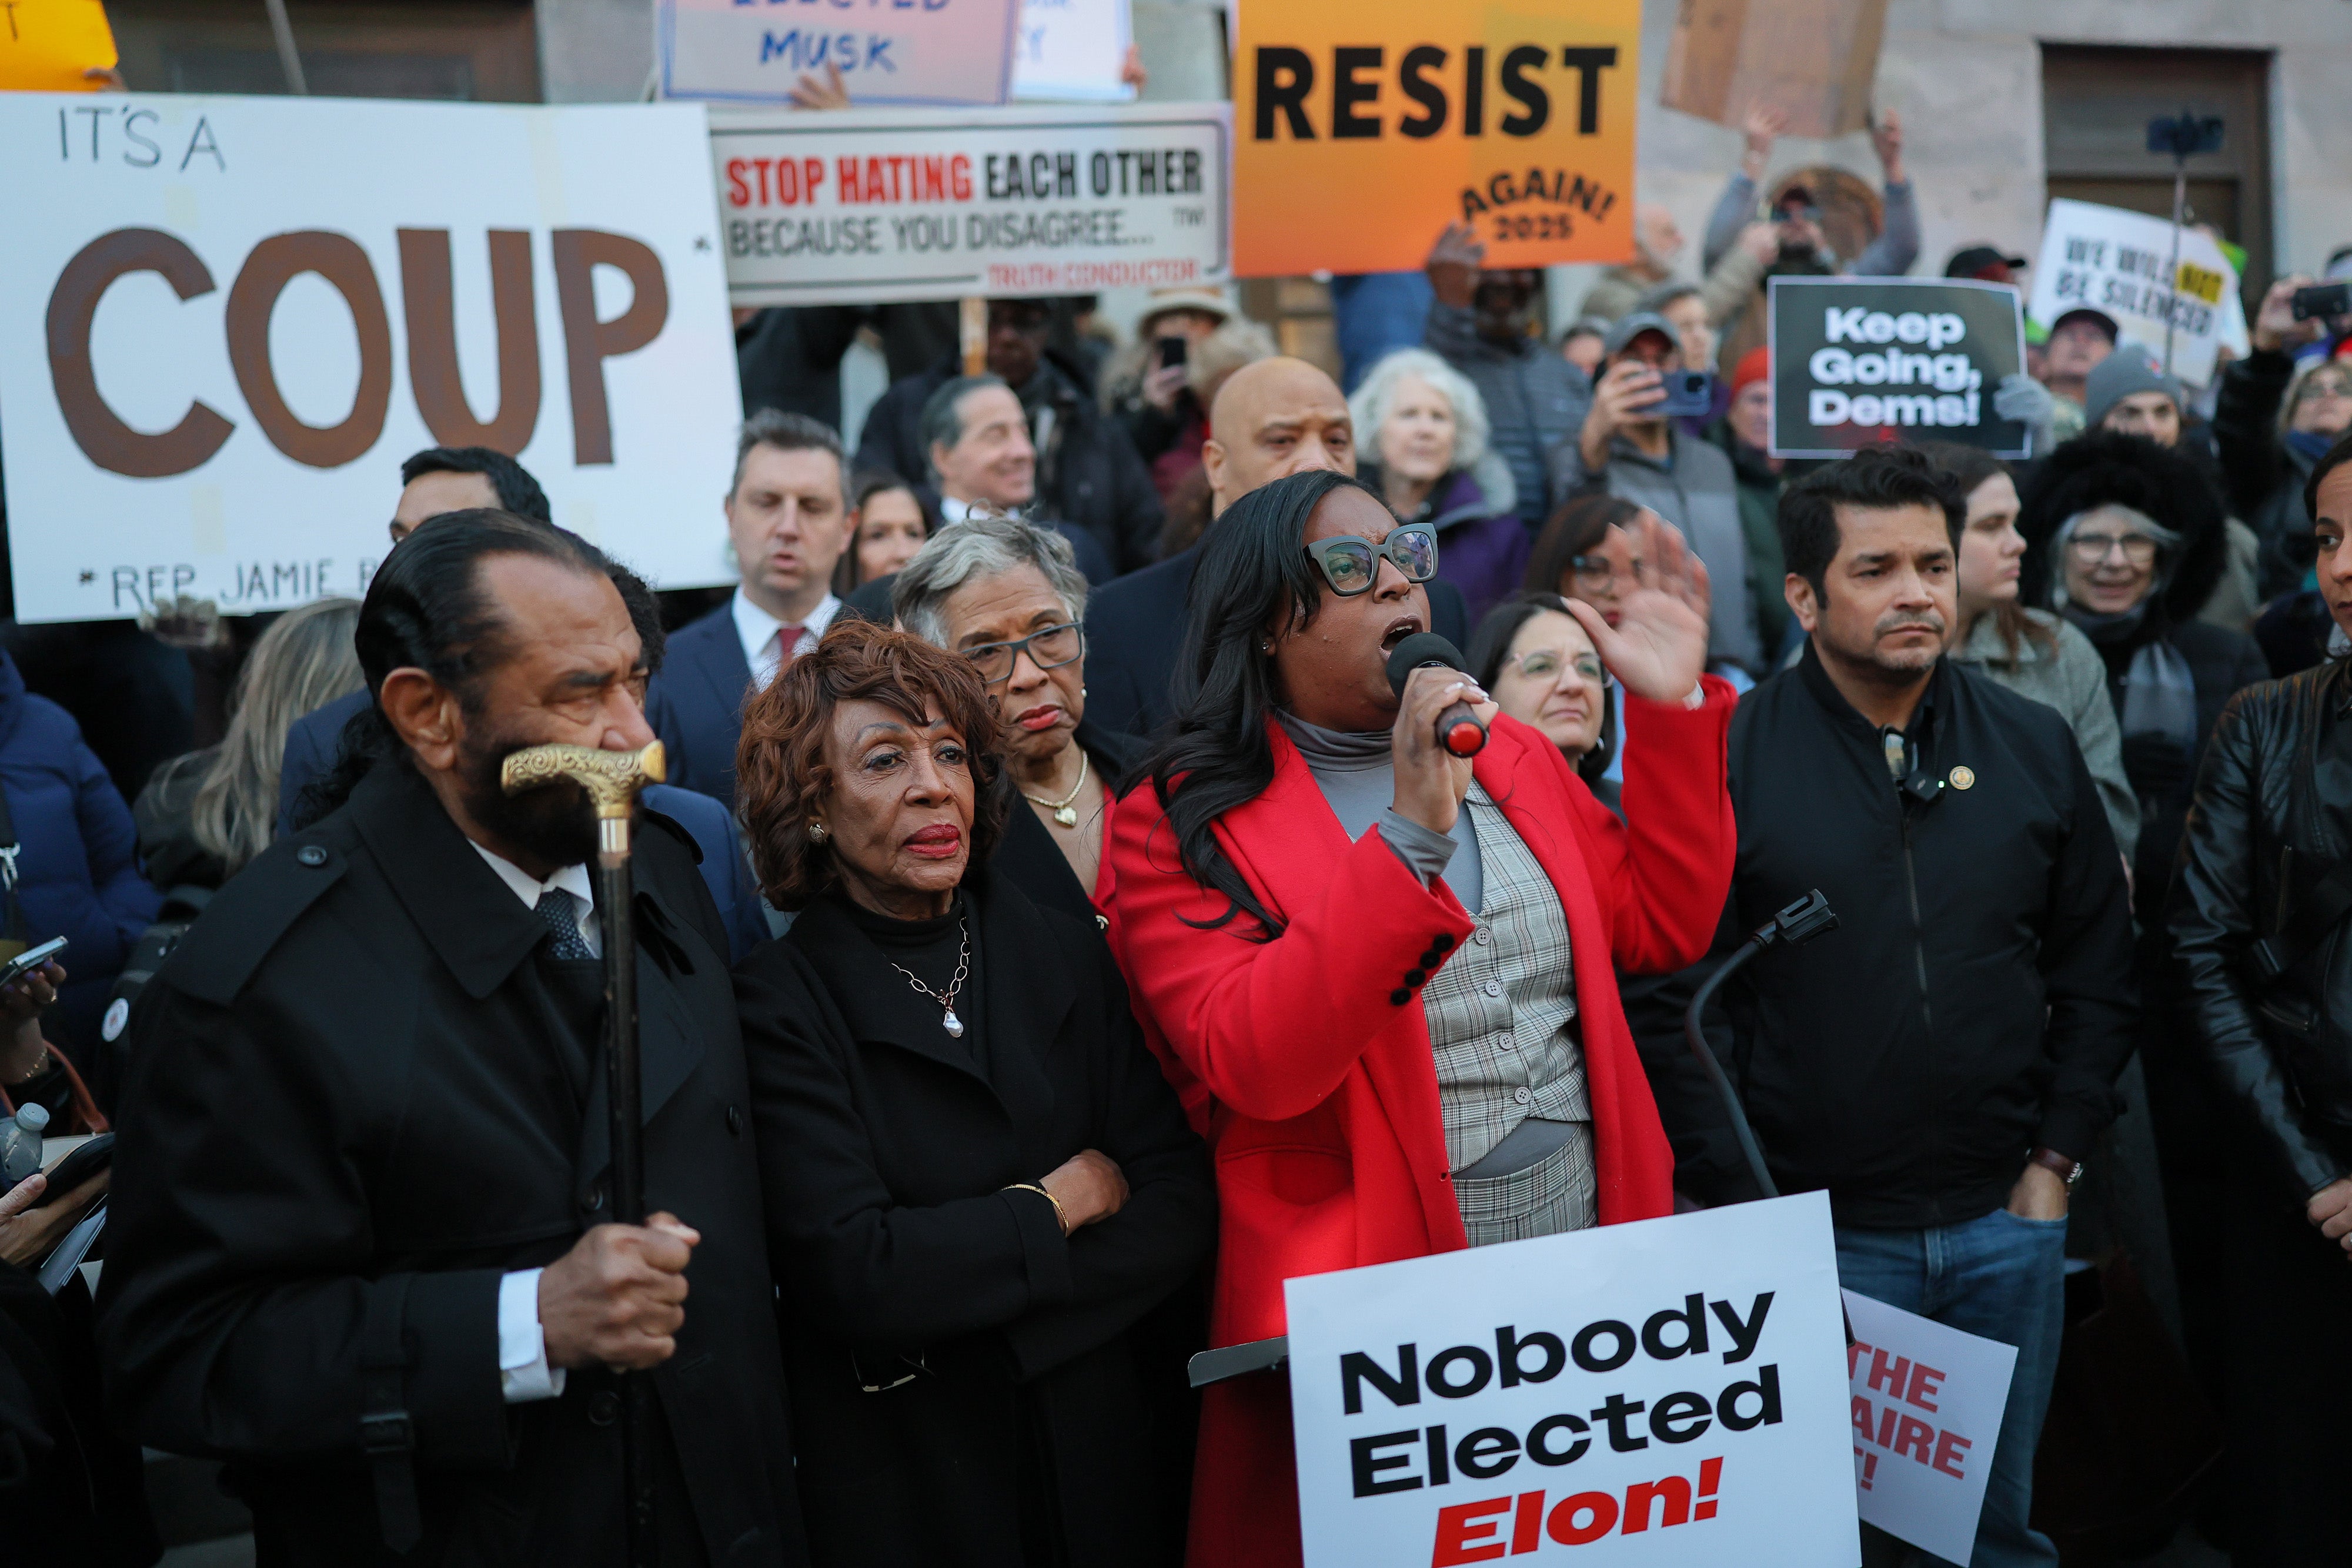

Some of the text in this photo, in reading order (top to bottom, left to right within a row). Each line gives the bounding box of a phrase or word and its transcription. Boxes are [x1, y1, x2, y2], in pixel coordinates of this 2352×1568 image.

[759, 28, 897, 73] MUSK
[1254, 46, 1618, 140] RESIST
[59, 104, 227, 172] IT'S A
[726, 148, 1202, 208] STOP HATING EACH OTHER
[1462, 168, 1614, 222] AGAIN!
[729, 215, 883, 257] BECAUSE
[890, 213, 957, 251] YOU
[1496, 214, 1573, 239] 2025
[2066, 236, 2107, 270] WE
[988, 259, 1197, 288] TRUTH CONDUCTOR
[1825, 307, 1966, 350] Keep
[2058, 268, 2214, 338] BE SILENCED
[46, 227, 668, 478] COUP
[1809, 347, 1982, 392] Going,
[1809, 389, 1981, 427] Dems!
[219, 557, 335, 605] JAMIE
[1340, 1292, 1775, 1415] Nobody
[1848, 1340, 1946, 1413] THE
[1350, 1363, 1783, 1497] Elected
[1431, 1456, 1723, 1567] Elon!
